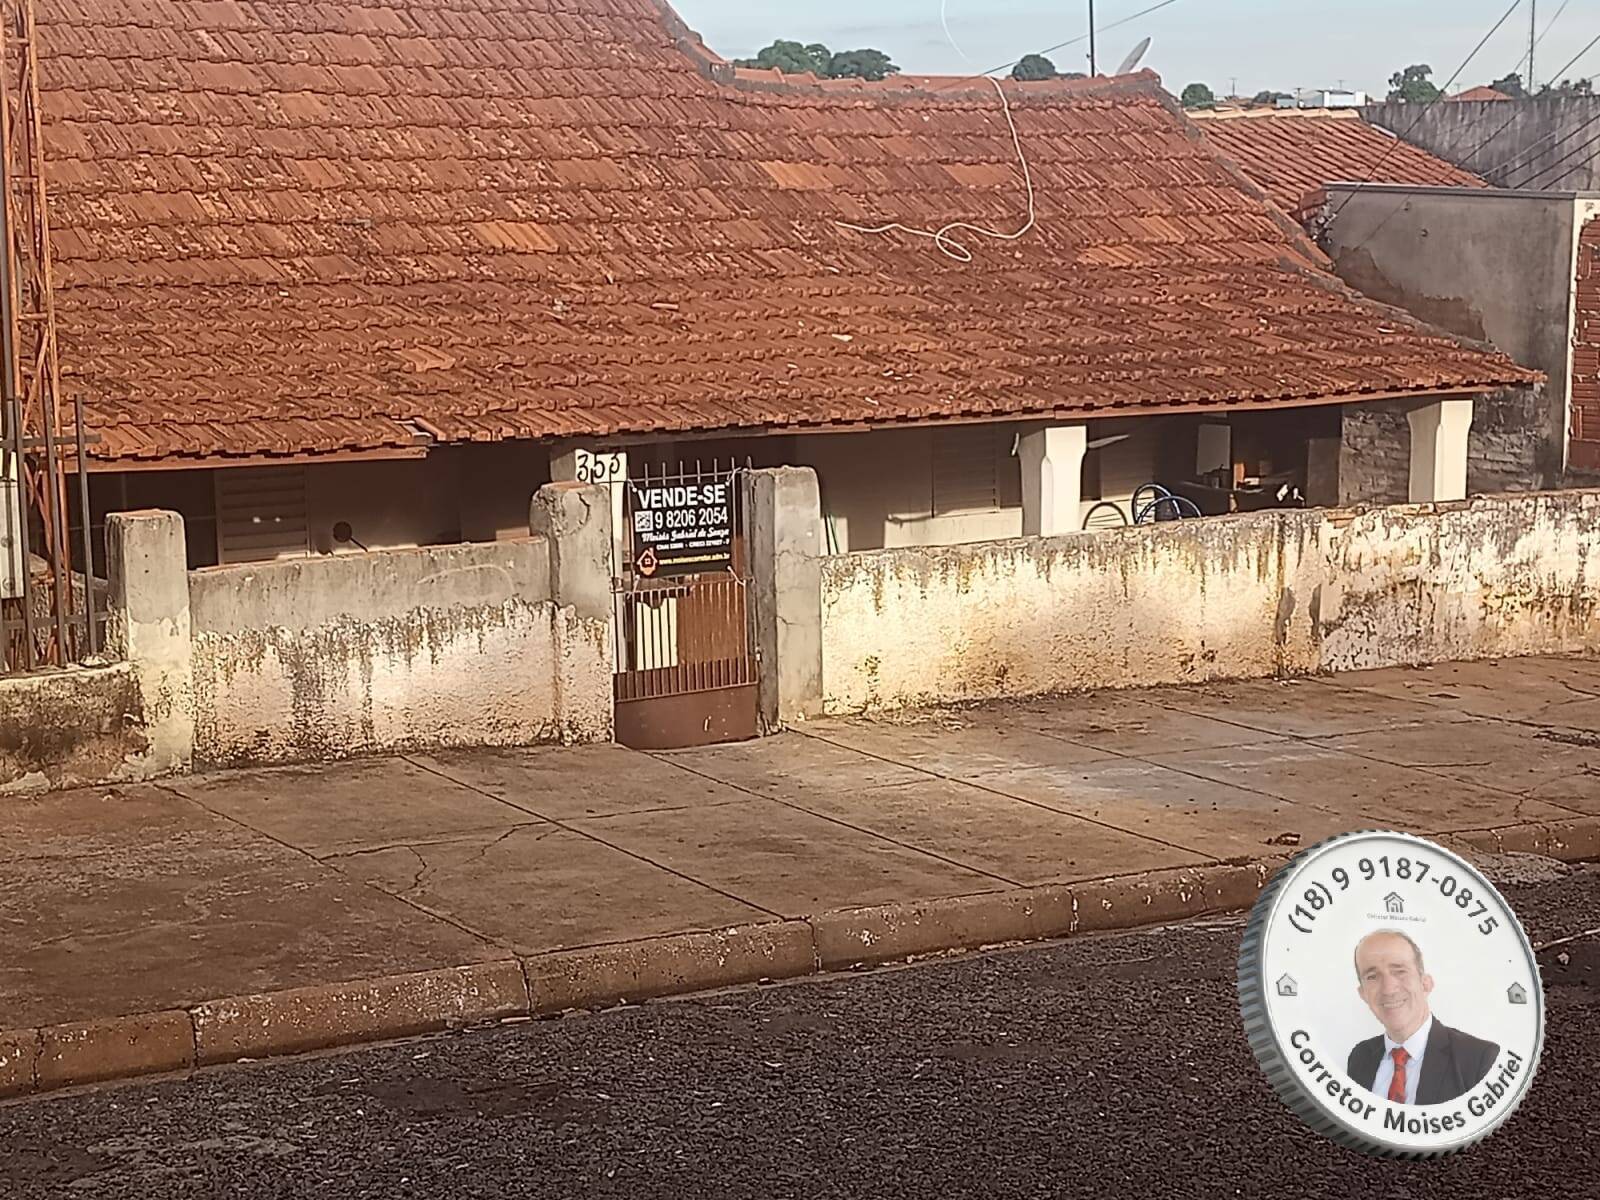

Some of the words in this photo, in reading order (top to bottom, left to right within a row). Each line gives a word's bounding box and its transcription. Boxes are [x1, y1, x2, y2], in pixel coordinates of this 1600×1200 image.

[576, 452, 622, 484] 353
[638, 484, 727, 510] VENDE-SE
[654, 511, 664, 529] 9
[665, 509, 696, 529] 8206
[698, 506, 729, 526] 2054
